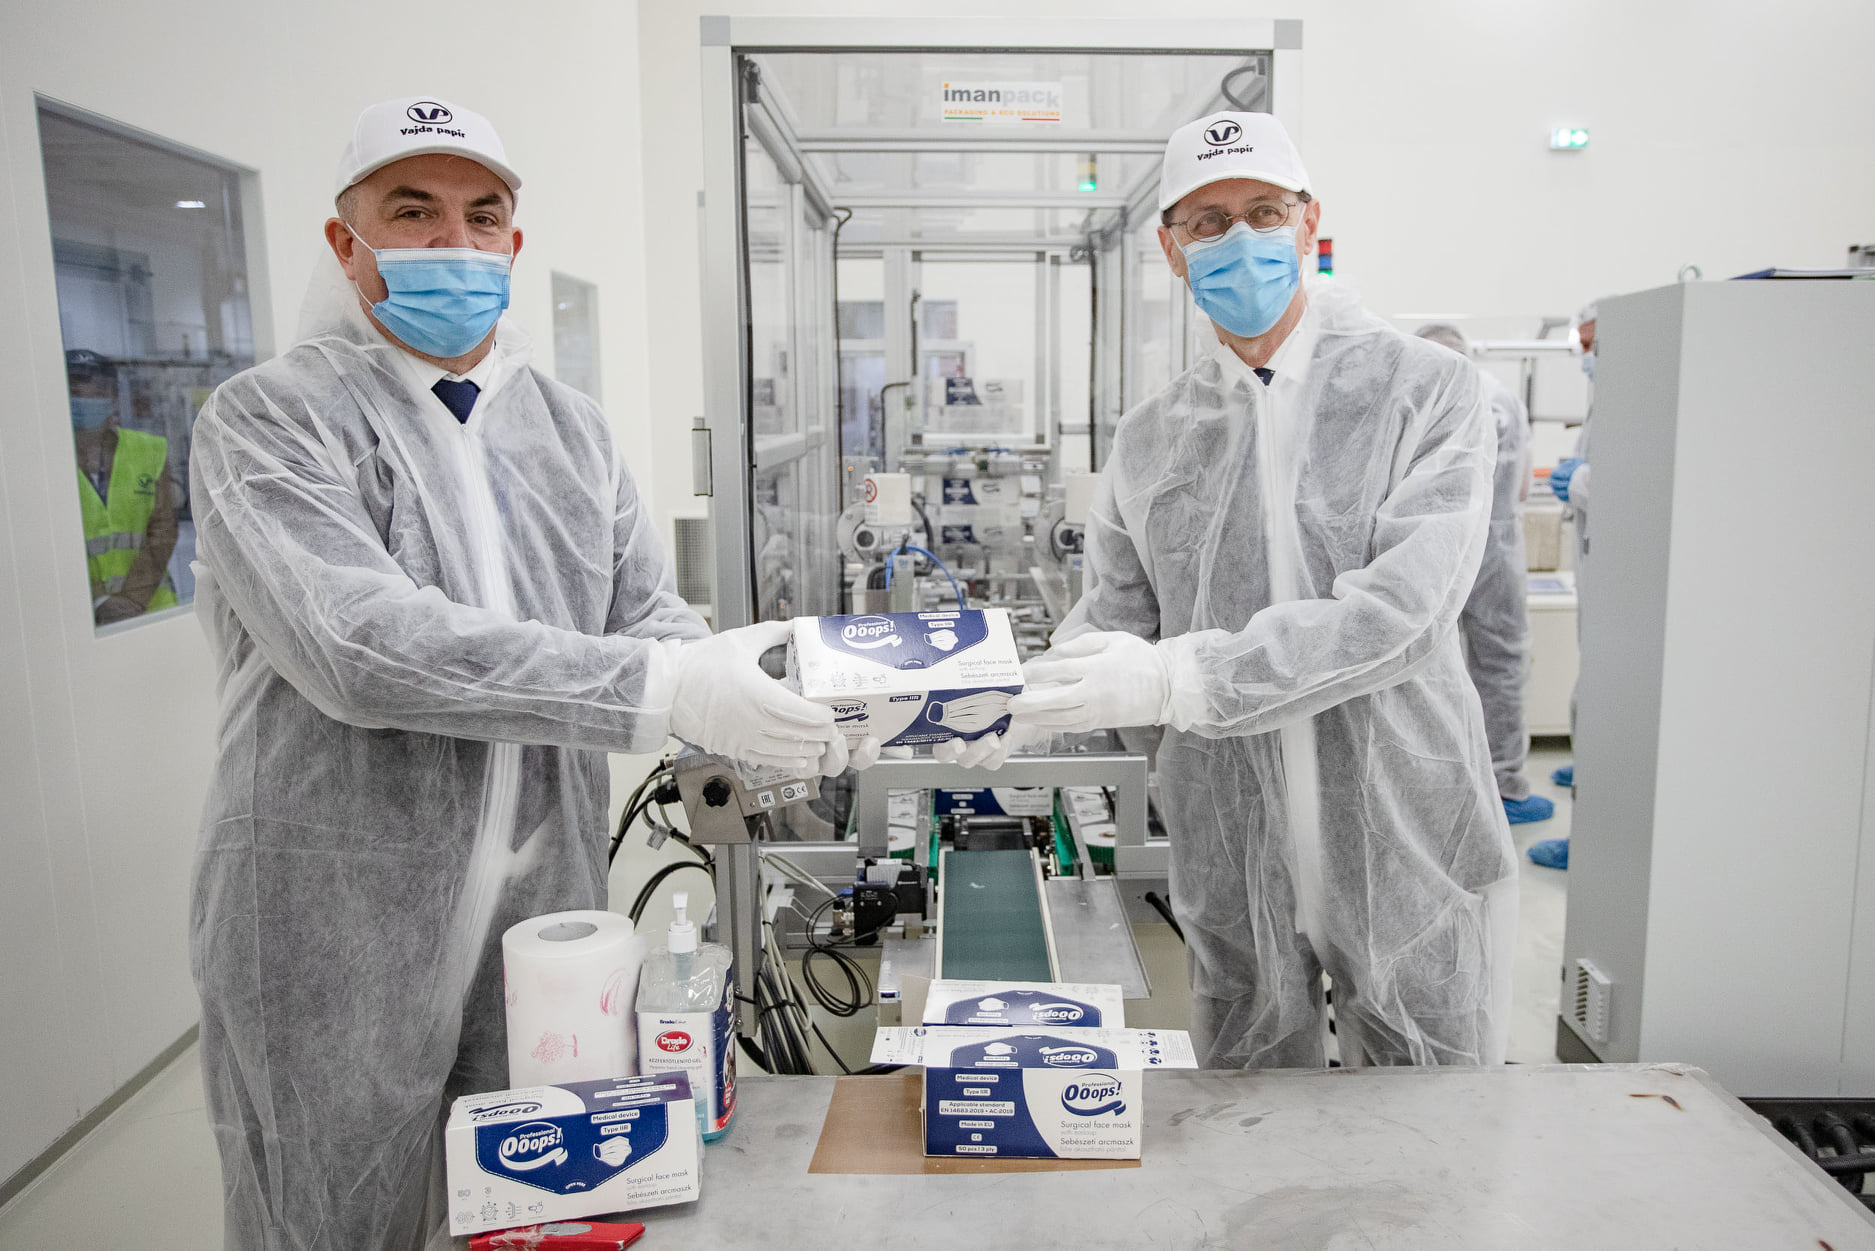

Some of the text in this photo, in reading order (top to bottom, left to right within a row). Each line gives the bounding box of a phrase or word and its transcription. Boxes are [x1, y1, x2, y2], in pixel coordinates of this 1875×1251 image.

[944, 83, 1060, 107] imanpack
[400, 125, 433, 135] Vajda
[1197, 148, 1224, 161] Vajda
[592, 1111, 639, 1121] Medical device
[1060, 1121, 1092, 1130] Surgical
[1094, 1120, 1110, 1128] face
[520, 1128, 555, 1139] Professional
[1060, 1137, 1096, 1145] Sebészeti
[626, 1169, 689, 1184] Surgical face mask
[627, 1188, 659, 1200] Sebészeti
[660, 1184, 692, 1194] arcmaszk
